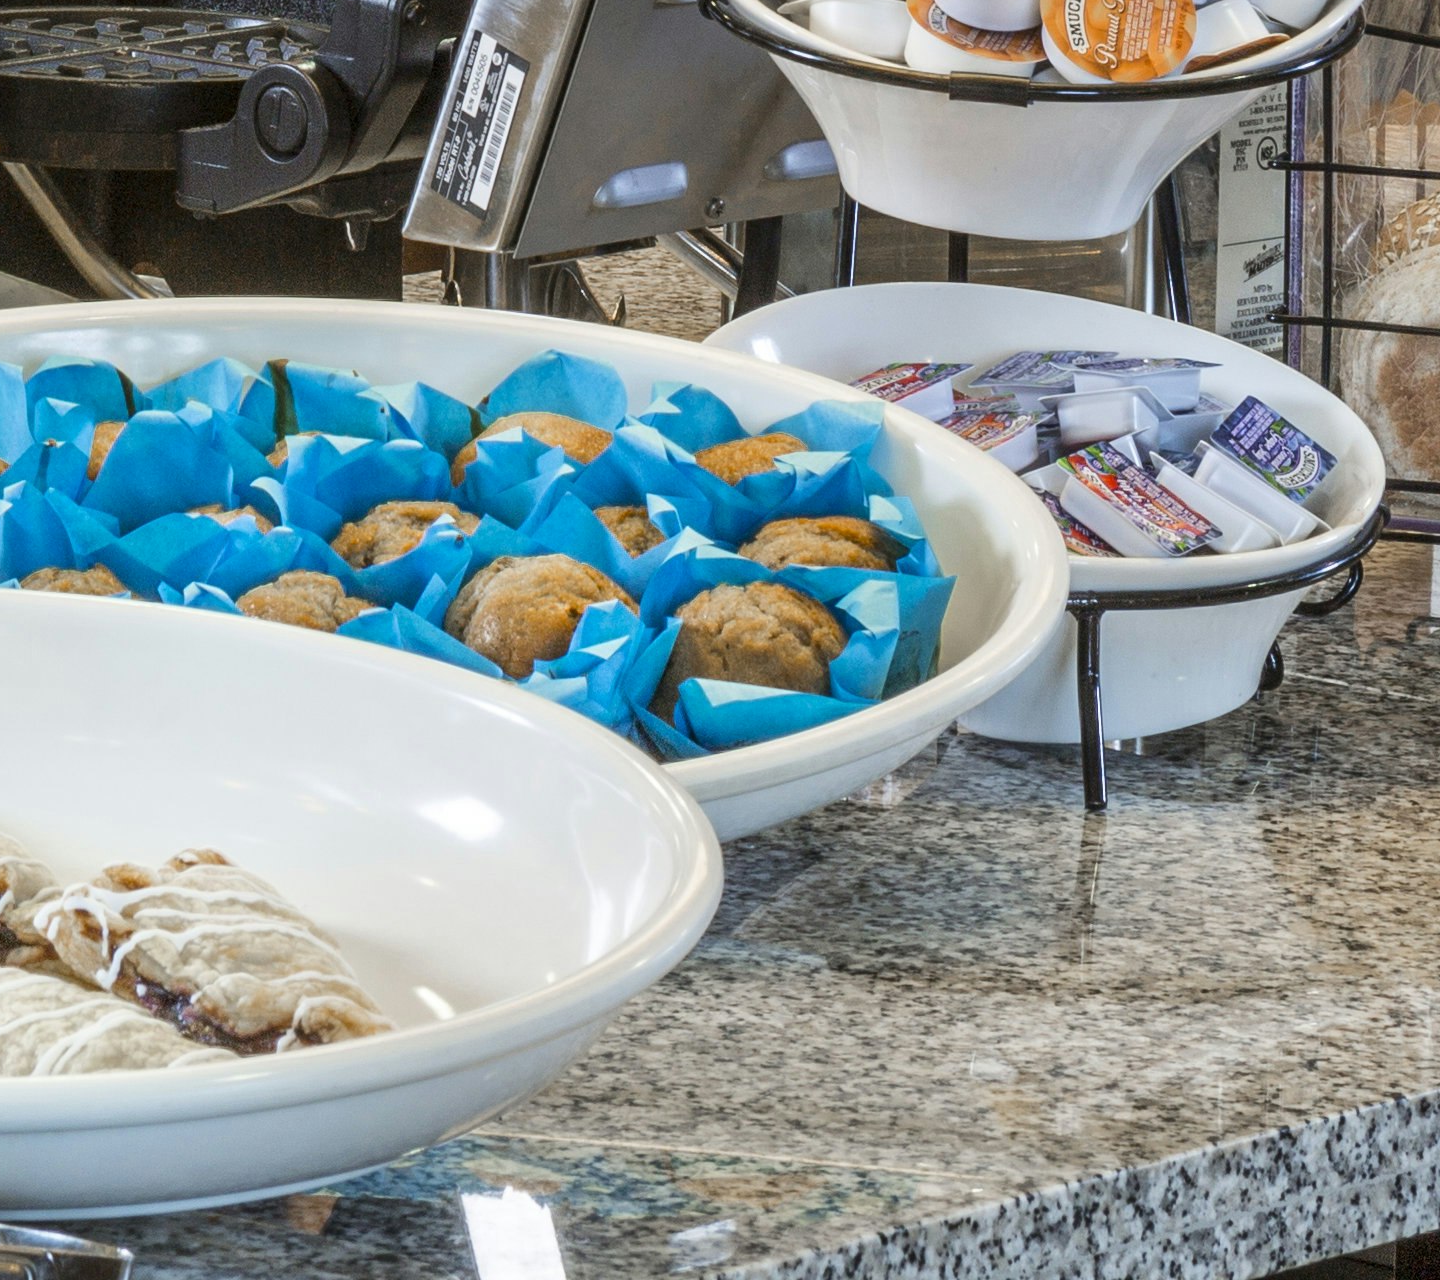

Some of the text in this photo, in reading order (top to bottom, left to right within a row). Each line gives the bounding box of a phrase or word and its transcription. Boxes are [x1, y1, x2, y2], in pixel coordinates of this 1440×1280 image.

[1093, 12, 1121, 69] Peanut
[439, 141, 452, 166] VOLTS
[468, 40, 480, 62] WATTS
[1230, 138, 1252, 149] MODEL
[443, 158, 456, 184] Model
[450, 135, 462, 158] RT-P
[1236, 292, 1284, 307] SERVER PRODUC
[1230, 316, 1268, 330] NEW CARBO
[1232, 329, 1259, 340] WILLIAM
